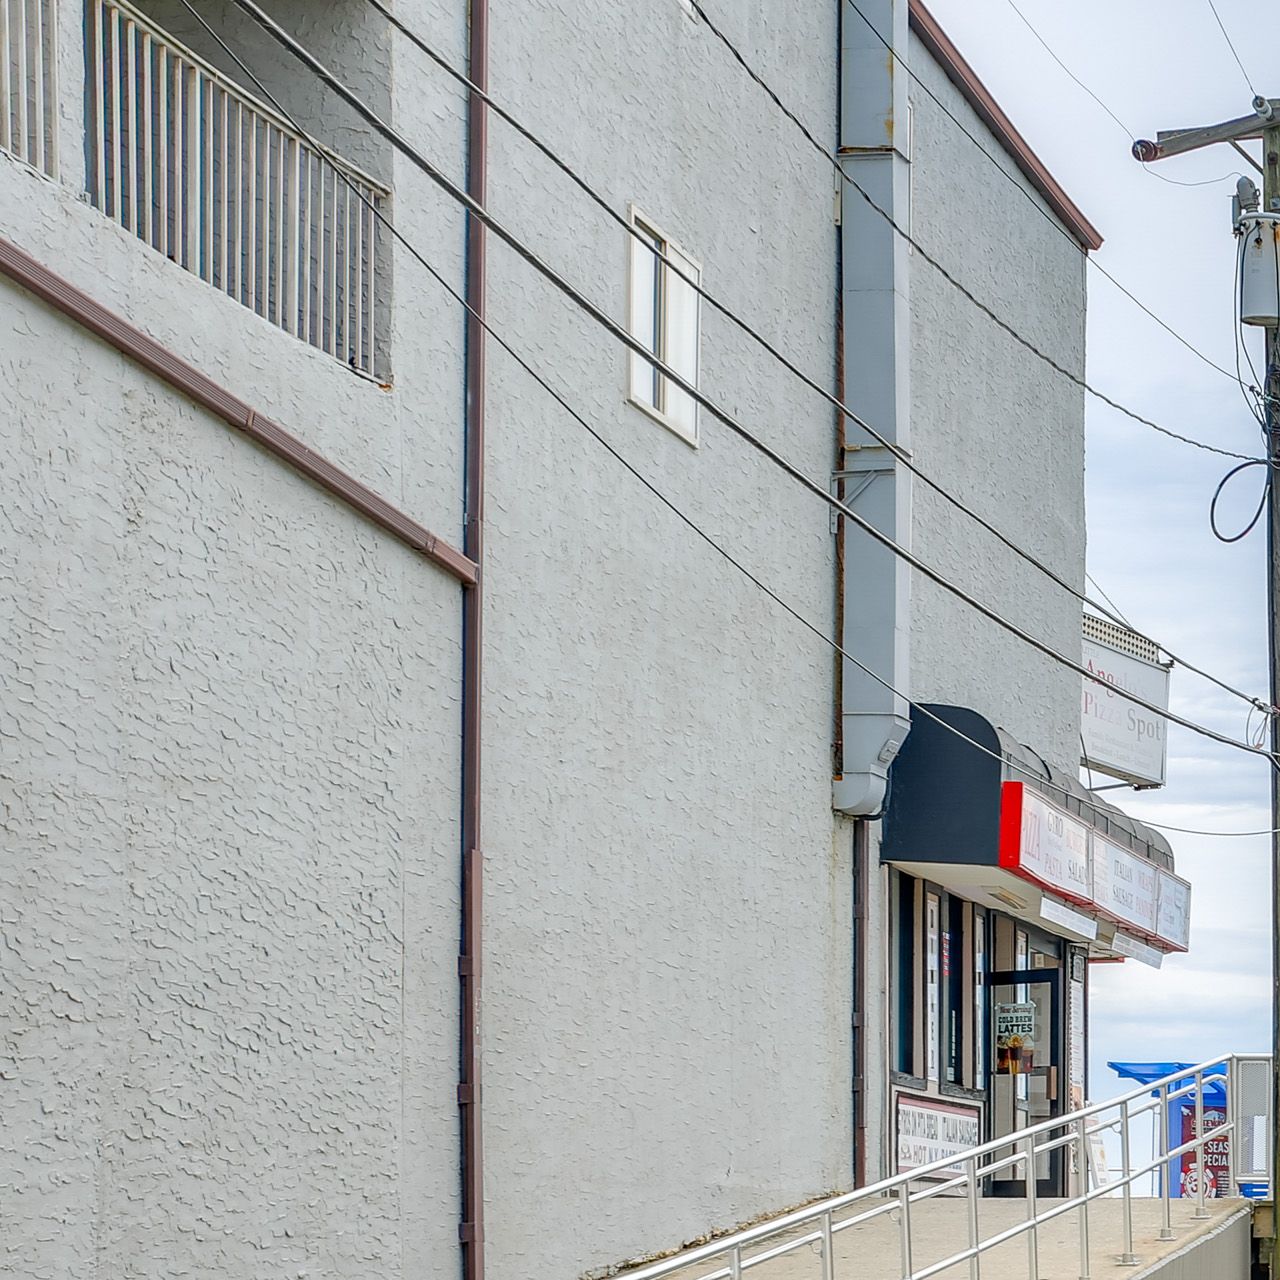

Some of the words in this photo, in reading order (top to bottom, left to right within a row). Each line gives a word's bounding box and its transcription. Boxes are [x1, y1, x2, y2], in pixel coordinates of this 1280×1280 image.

[1127, 707, 1161, 741] Spot
[998, 1015, 1014, 1023] COLD
[1015, 1015, 1033, 1023] BREW
[998, 1023, 1033, 1034] LATTES
